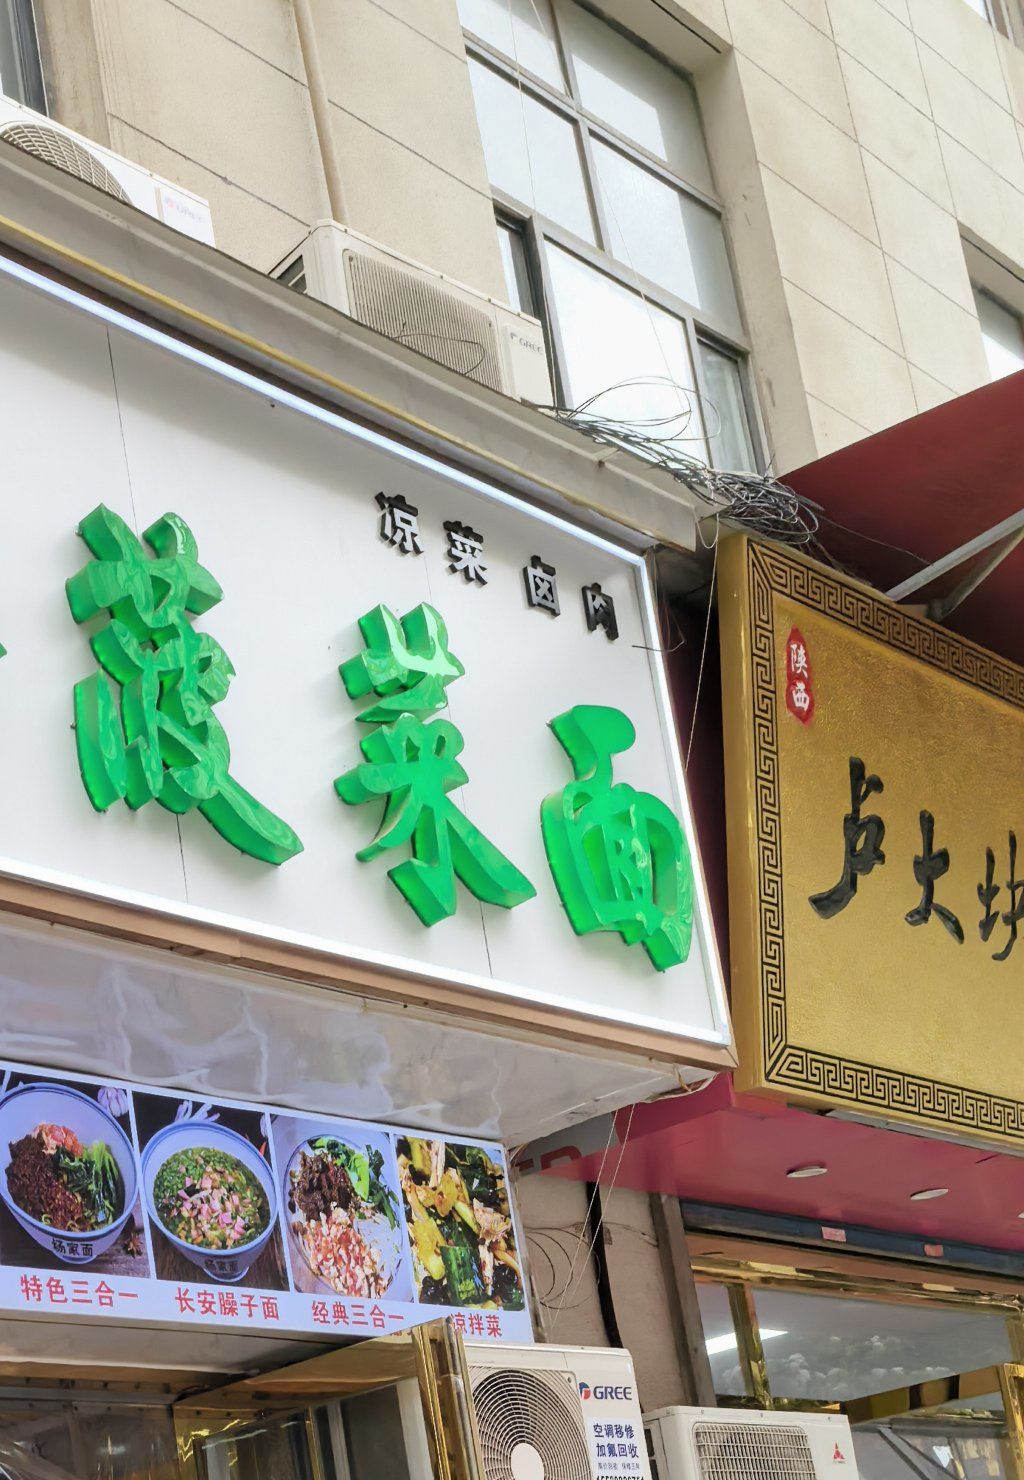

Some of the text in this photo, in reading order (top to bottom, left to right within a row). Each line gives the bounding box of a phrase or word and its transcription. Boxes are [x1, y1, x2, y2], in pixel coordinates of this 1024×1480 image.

[375, 491, 619, 641] 凉菜卤肉
[788, 643, 811, 712] 陕西
[51, 1238, 93, 1257] 杨家面
[21, 1274, 138, 1307] 特色三合一
[175, 1287, 279, 1320] 长安臊子面
[312, 1300, 404, 1330] 经典三合一
[451, 1312, 502, 1338] 凉拌菜
[593, 1386, 632, 1400] GREE
[593, 1423, 634, 1439] 空调移修
[596, 1443, 639, 1458] 加氟回收
